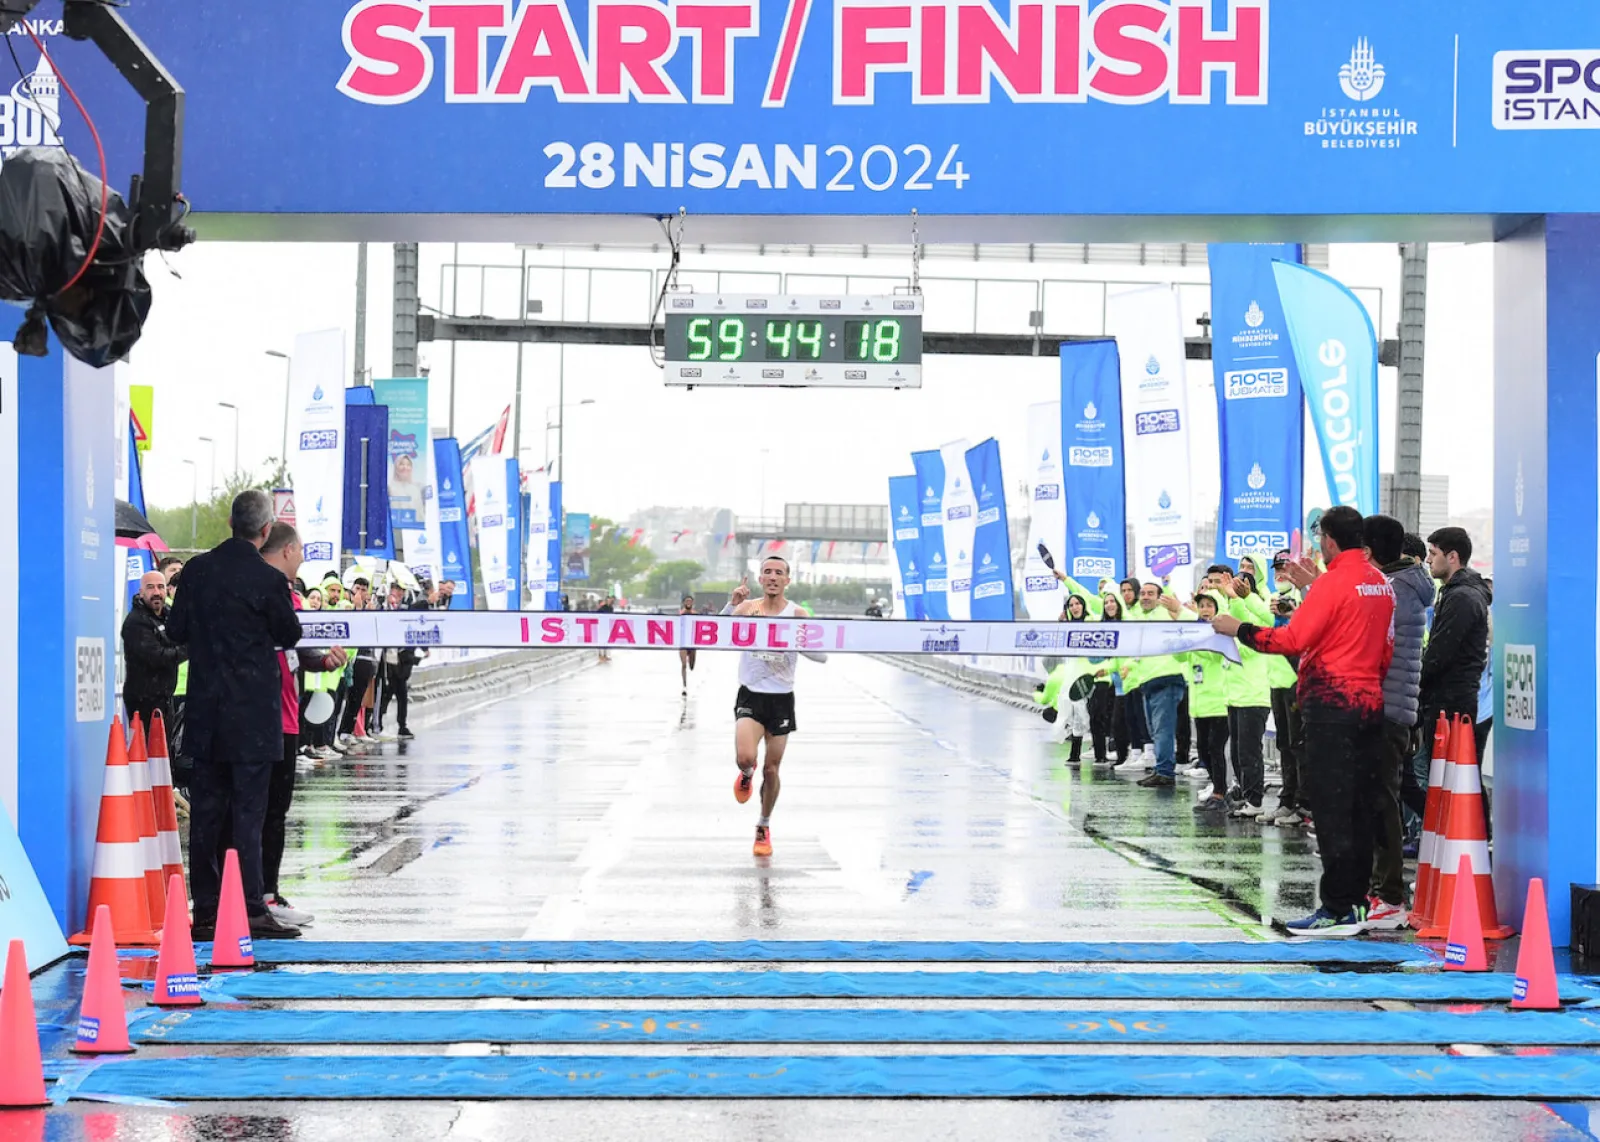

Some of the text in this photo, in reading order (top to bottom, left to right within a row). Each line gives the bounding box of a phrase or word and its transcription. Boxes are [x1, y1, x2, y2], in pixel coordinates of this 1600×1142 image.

[337, 0, 759, 104] START
[833, 0, 1268, 105] FINISH
[1321, 107, 1400, 118] İSTANBUL
[1304, 119, 1418, 137] BÜYÜKŞEHİR
[1321, 138, 1400, 149] BELEDİYESİ
[542, 141, 615, 189] 28
[825, 144, 970, 192] 2024
[520, 617, 789, 648] ISTANBUL
[1070, 631, 1116, 641] SPOR
[1506, 653, 1533, 693] SPOR
